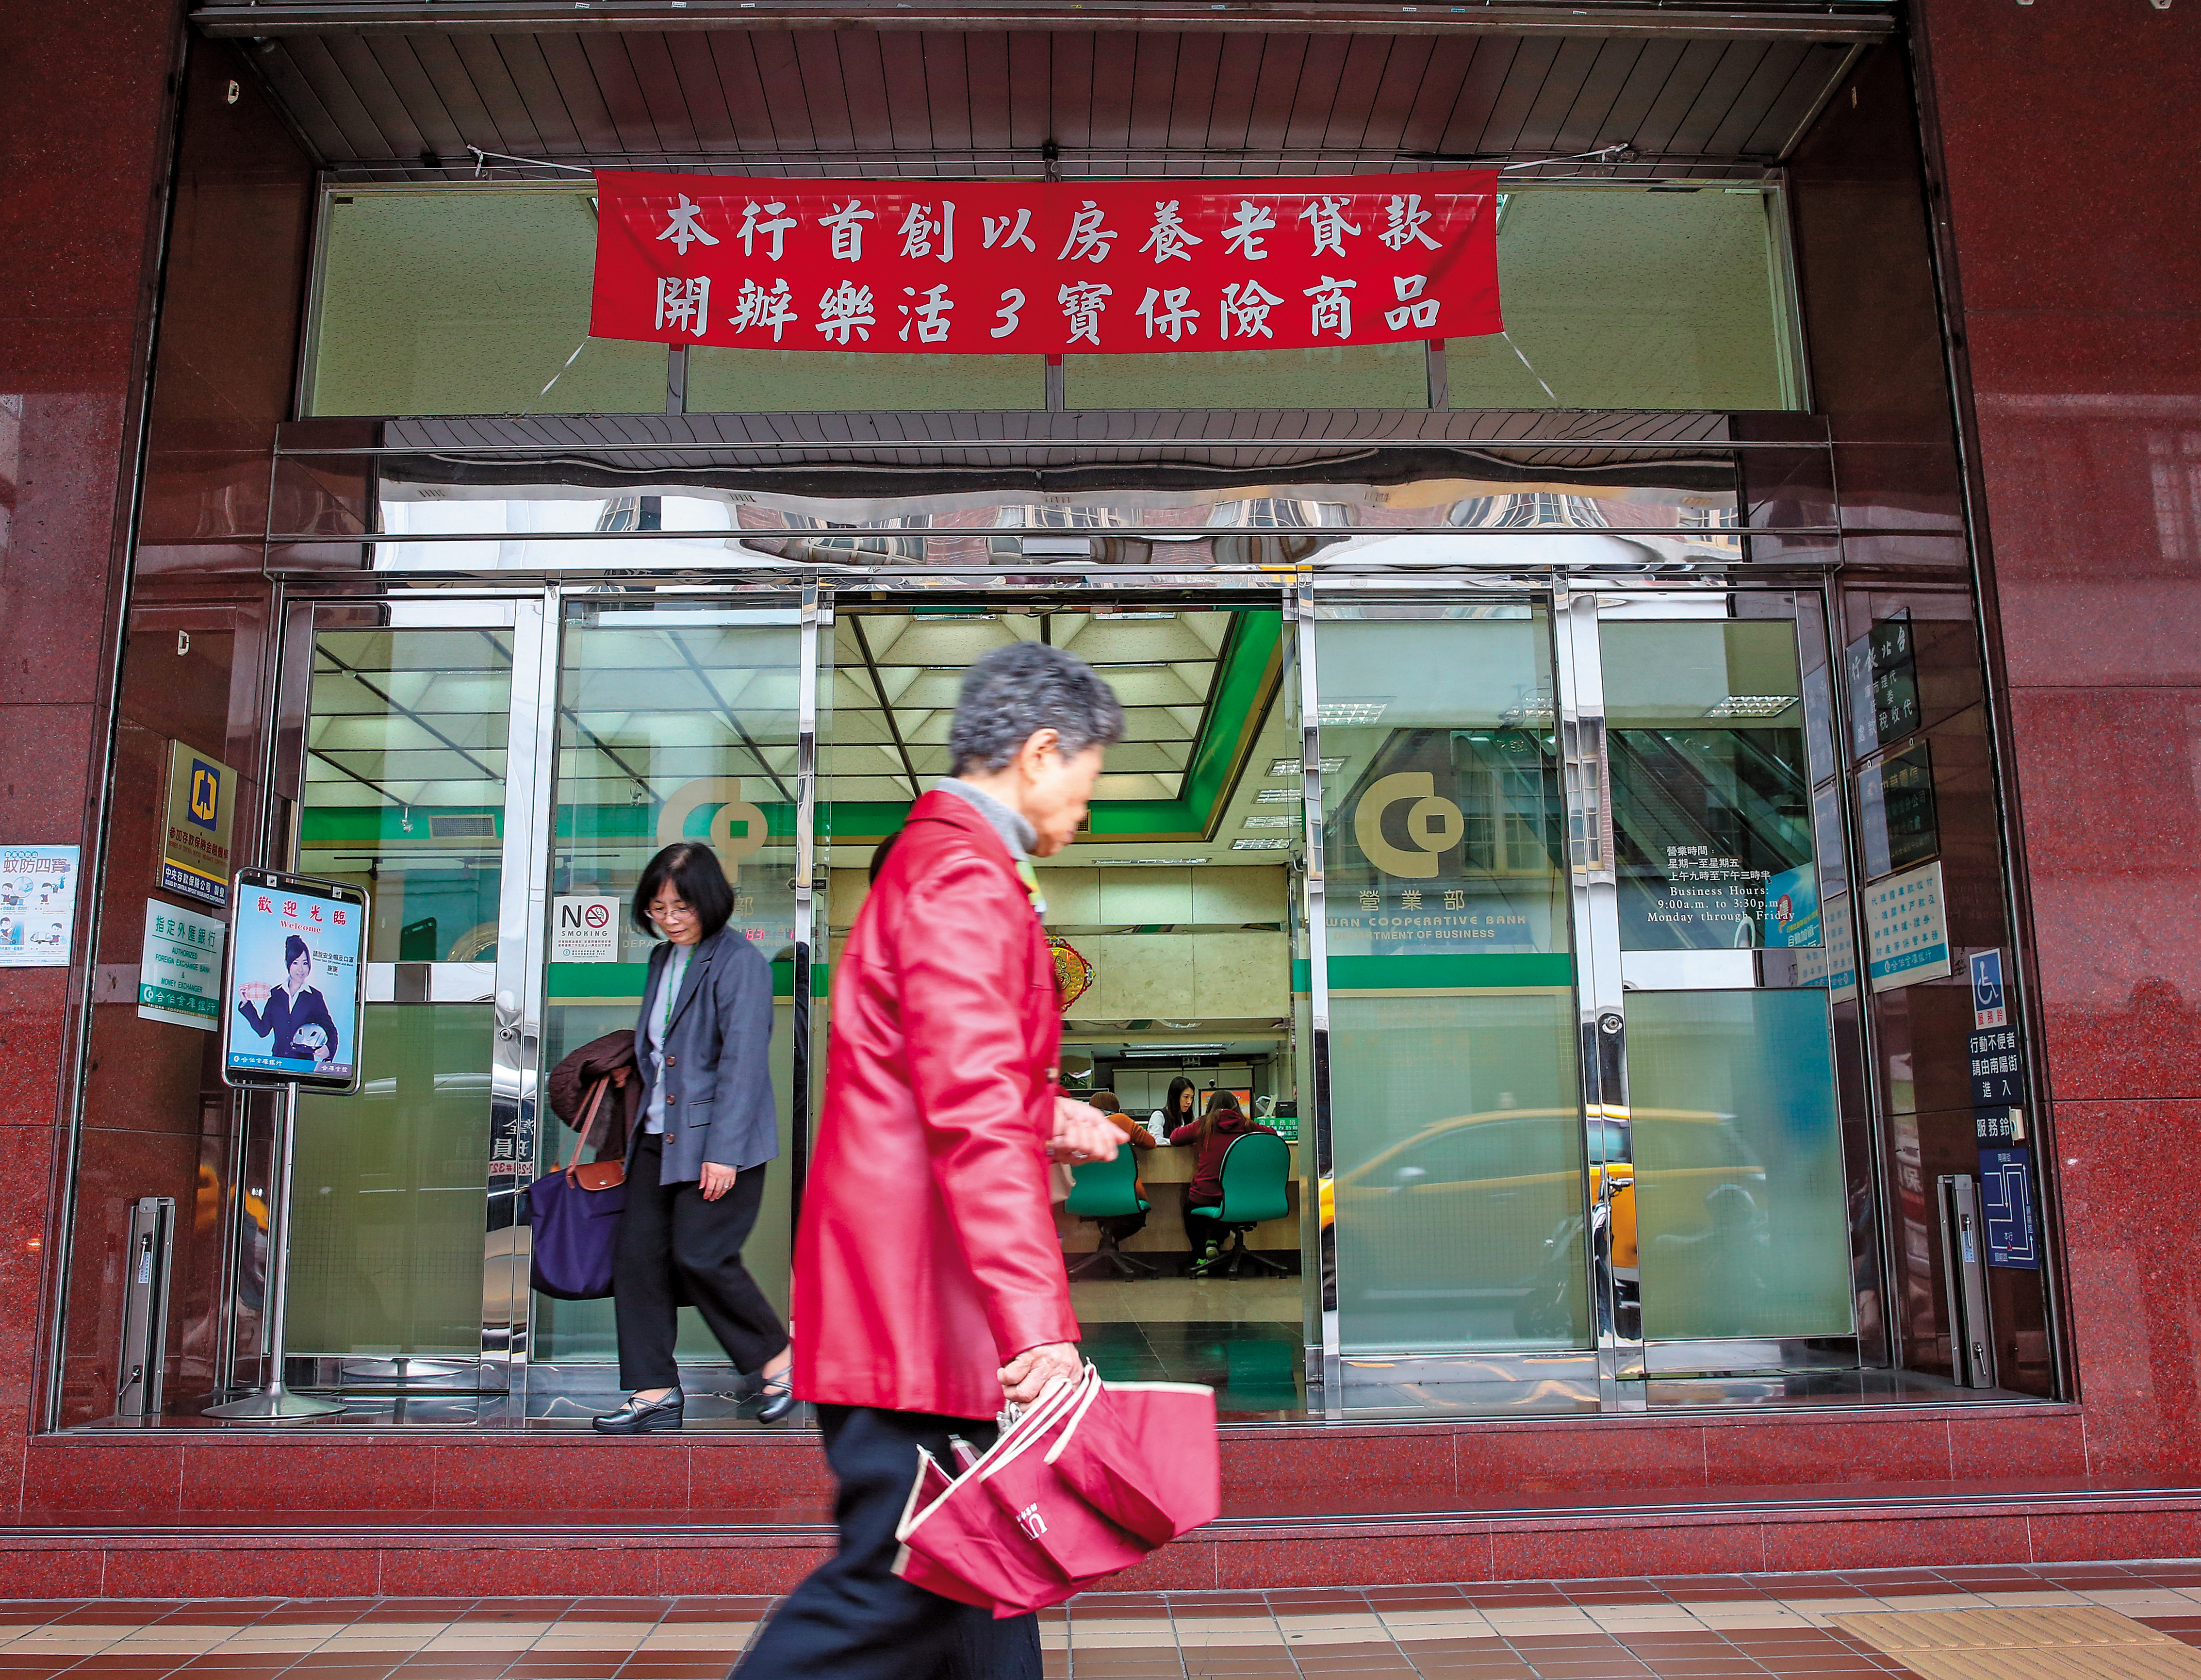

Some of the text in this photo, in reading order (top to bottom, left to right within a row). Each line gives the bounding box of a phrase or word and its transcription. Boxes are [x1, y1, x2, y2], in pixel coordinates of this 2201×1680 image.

[655, 193, 1443, 264] 本行首創以房養老貸款
[655, 275, 1441, 346] 開辦樂活3寶保險商品
[3, 858, 67, 873] 蚊防四寶
[1667, 858, 1740, 869] 星期一至星期五
[1669, 871, 1771, 882] 上午九時至下午三時半
[1670, 886, 1769, 897] Business Hours:
[1359, 889, 1465, 912] 營業部
[1658, 900, 1709, 909] 9:00a.m.
[1715, 900, 1726, 908] to
[257, 896, 346, 925] 歡迎光臨
[1647, 912, 1693, 923] Monday
[1701, 911, 1749, 922] through
[1756, 910, 1795, 922] Friday
[280, 920, 322, 934] Welcome
[1369, 916, 1477, 927] COOPERATIVE
[1486, 915, 1527, 925] BANK
[155, 915, 216, 947] 指定外匯銀行
[1333, 929, 1495, 940] DEPARTMENT OF BUSINESS
[171, 947, 198, 960] AUTHORIZED
[155, 954, 211, 974] FOREIGN EXCHANGE BANK
[161, 977, 203, 993] MONEY EXCHANGER
[1970, 1031, 2015, 1054] 行動不便者
[1972, 1054, 2018, 1077] 請由南陽街
[1982, 1079, 2012, 1098] 進入
[1976, 1117, 2010, 1138] 服務鈴
